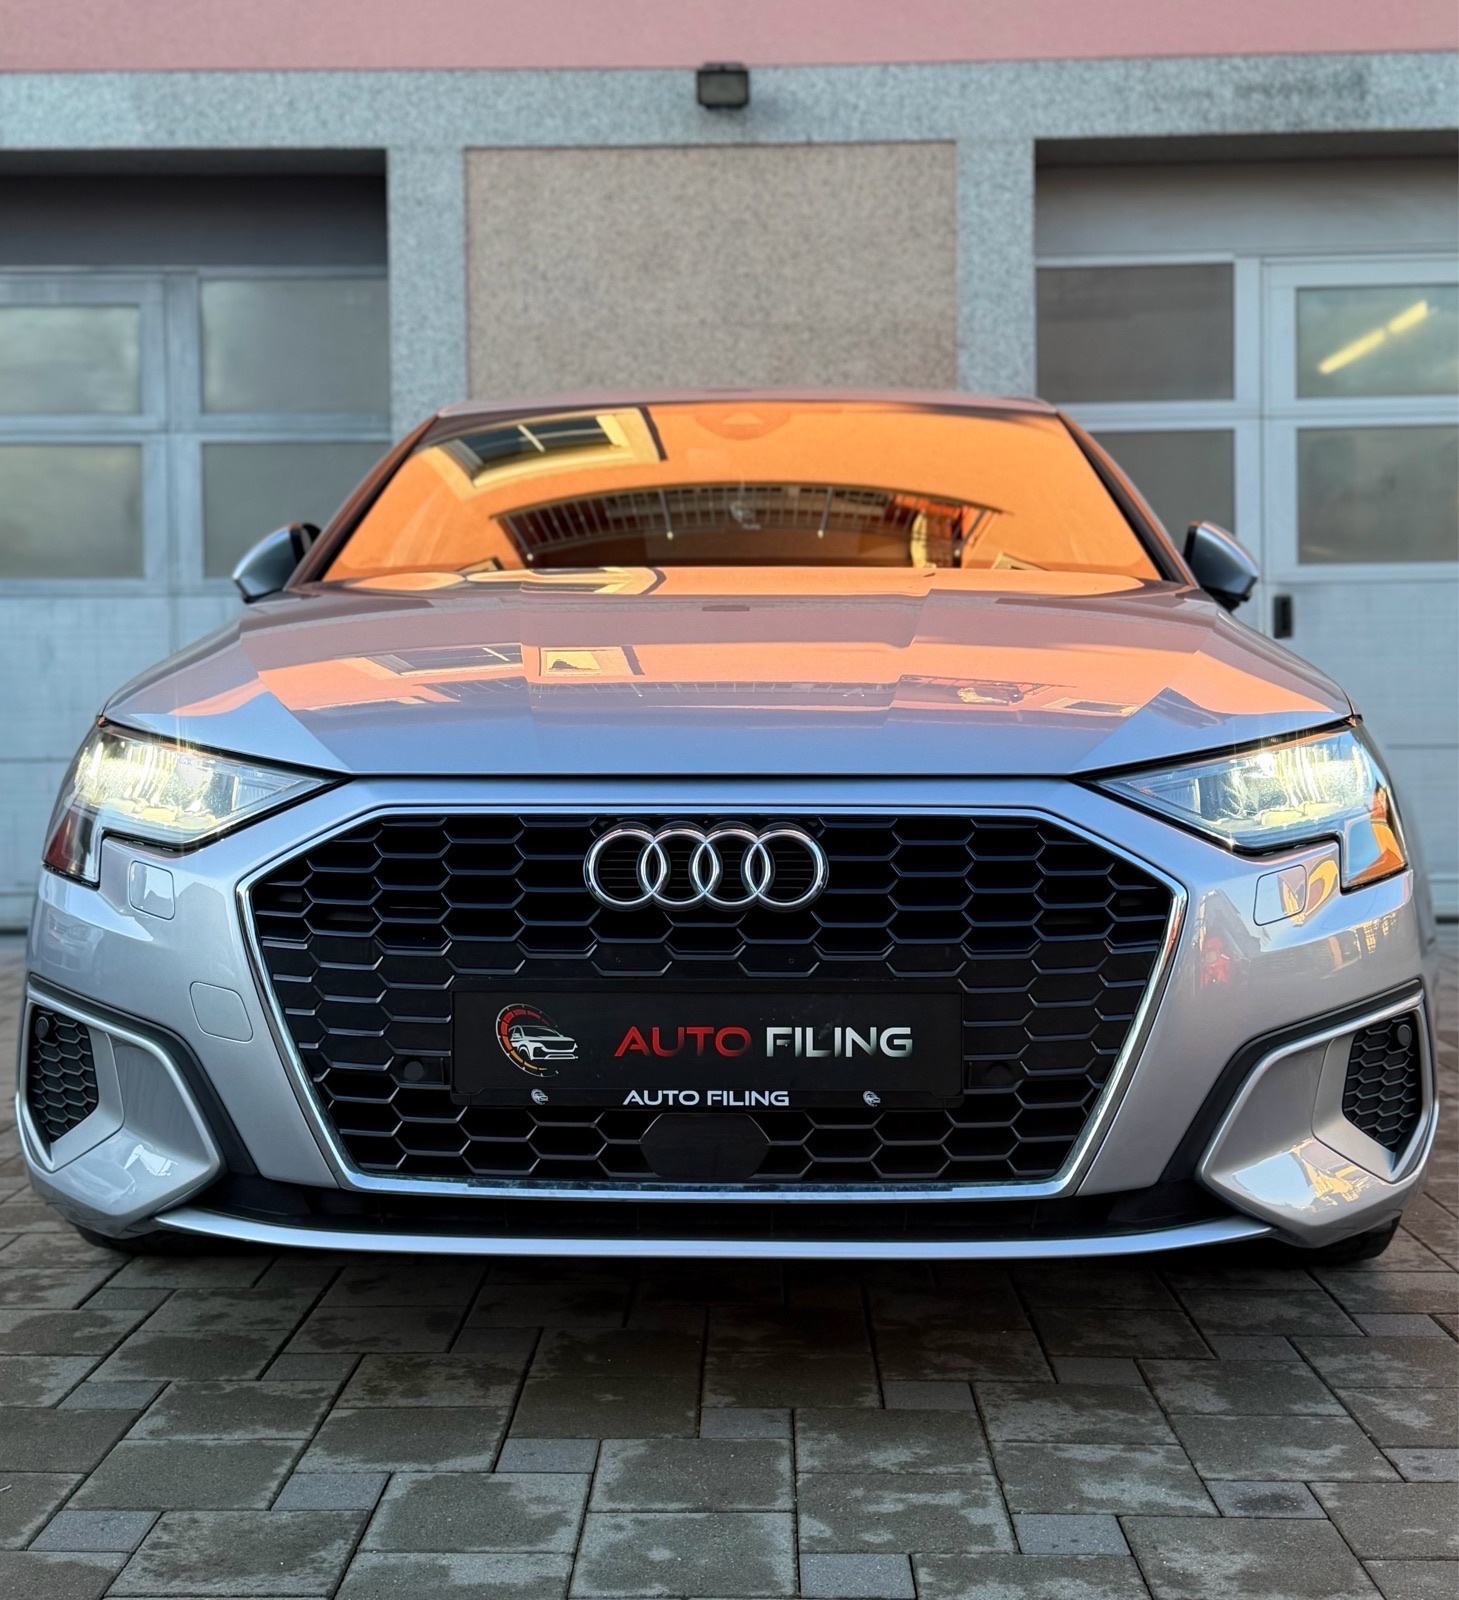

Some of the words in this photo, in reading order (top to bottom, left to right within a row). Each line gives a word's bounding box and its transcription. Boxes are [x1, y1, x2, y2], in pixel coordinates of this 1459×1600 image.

[614, 1026, 751, 1057] AUTO
[767, 1026, 913, 1058] FILING
[622, 1089, 700, 1106] AUTO
[706, 1090, 790, 1107] FILING
